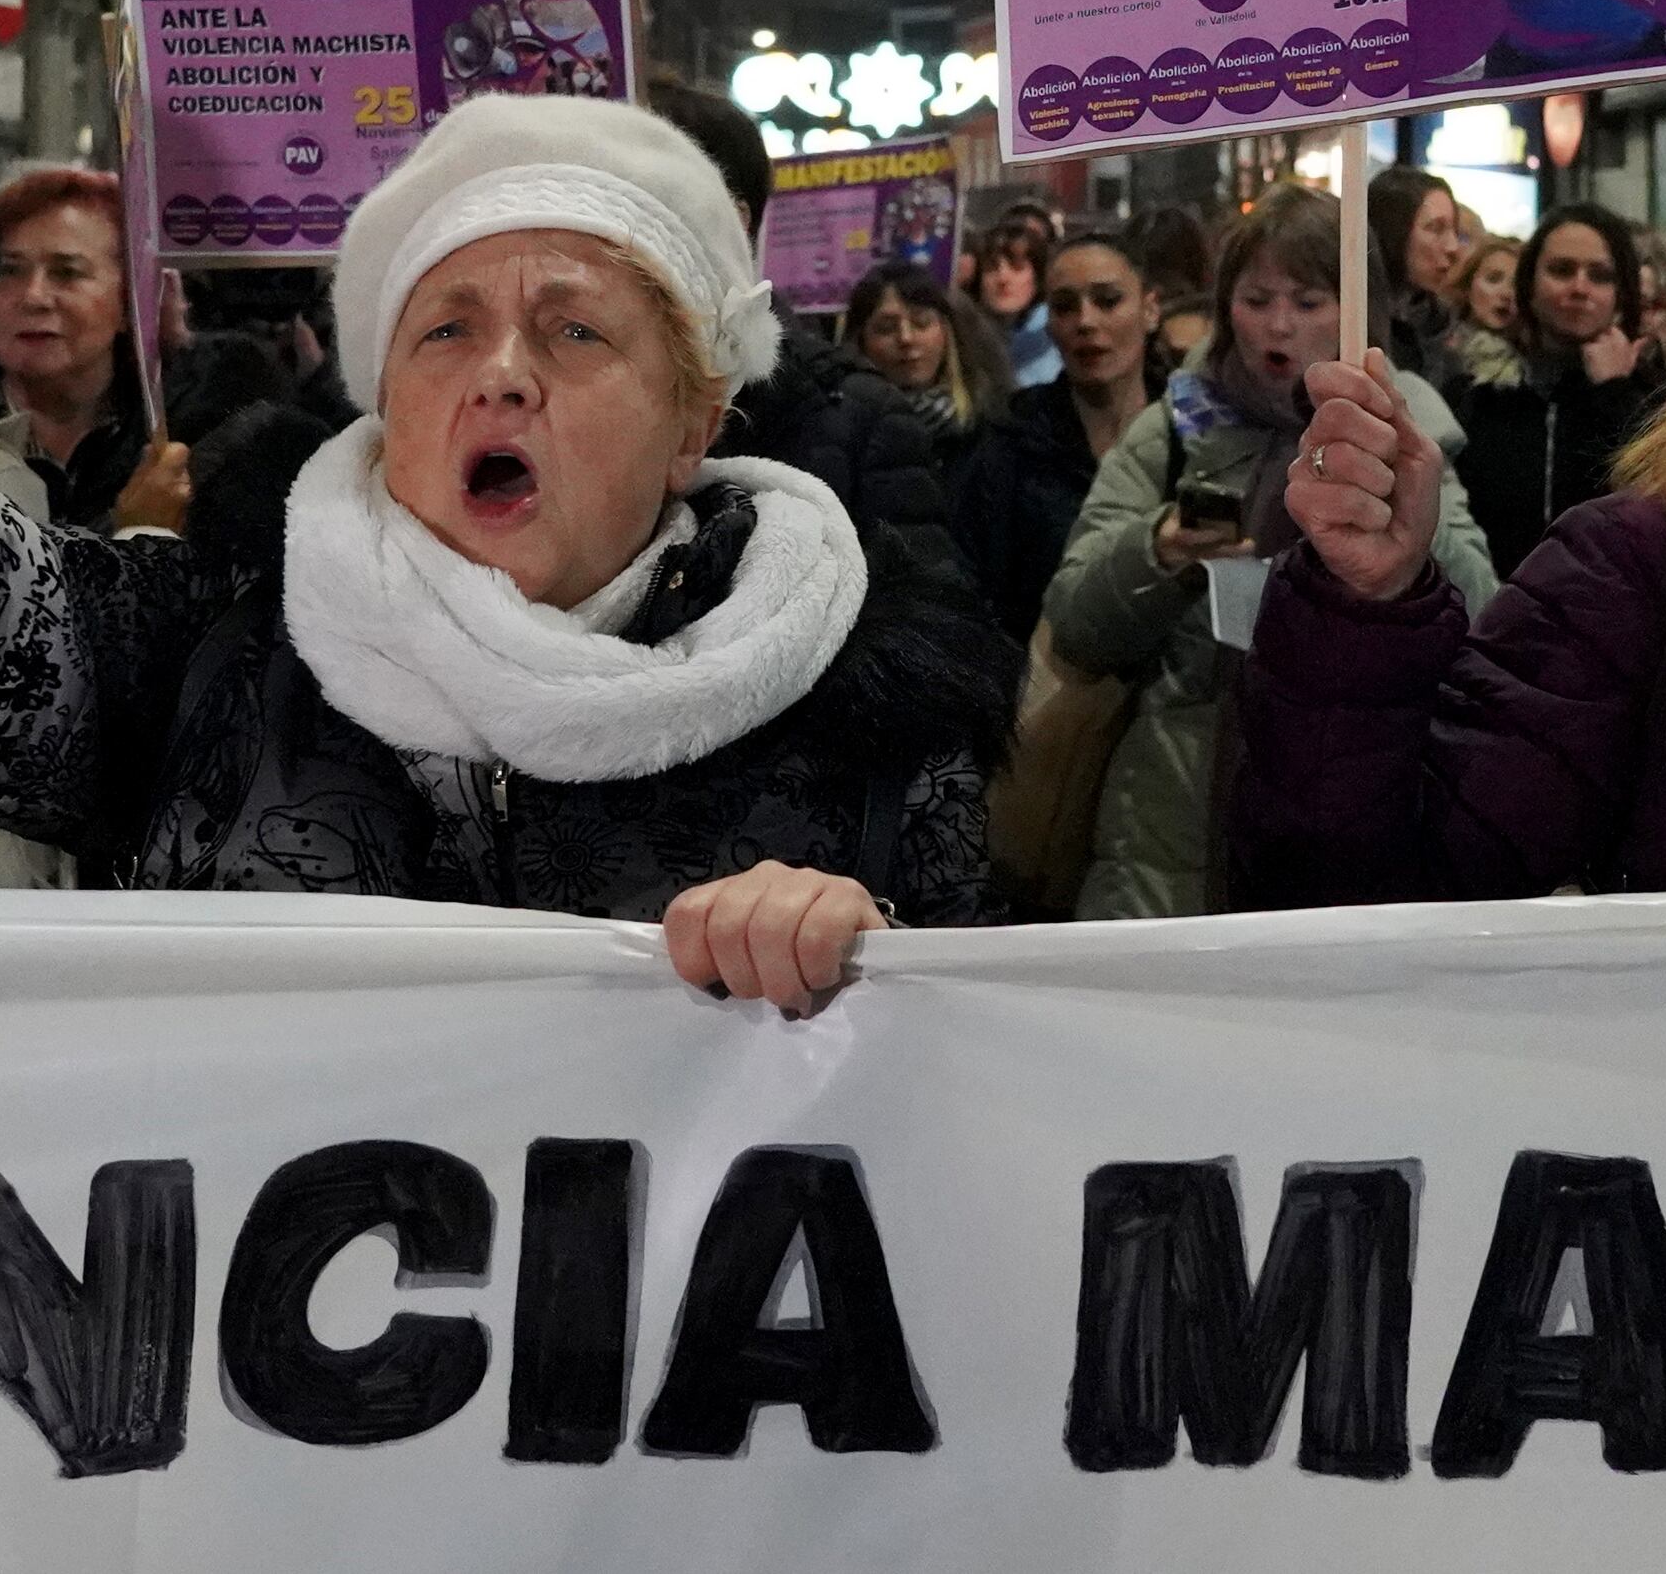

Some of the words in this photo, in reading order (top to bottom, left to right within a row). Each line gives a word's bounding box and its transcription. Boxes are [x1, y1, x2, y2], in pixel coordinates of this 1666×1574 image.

[161, 7, 228, 30] ANTE
[235, 7, 268, 29] LA
[1067, 11, 1074, 20] a
[1076, 5, 1120, 19] nuestro
[1123, 0, 1162, 13] cortejo
[1209, 10, 1257, 26] Valladolid
[162, 36, 286, 57] VIOLENCIA
[292, 34, 413, 56] MACHISTA
[1282, 41, 1342, 58] Abolición
[1350, 31, 1410, 50] Abolición
[1217, 51, 1275, 69] Abolición
[166, 60, 298, 87] ABOLICIÓN
[309, 66, 325, 84] Y
[1082, 70, 1141, 88] Abolición
[1148, 62, 1207, 80] Abolición
[1285, 68, 1327, 81] Vientres
[1328, 66, 1342, 76] de
[1022, 79, 1077, 99] Abolición
[1295, 79, 1334, 92] Alquiler
[168, 93, 325, 116] COEDUCACIÓN
[353, 85, 418, 126] 25
[1029, 106, 1070, 120] Violencia
[1087, 97, 1140, 111] Agresiones
[1030, 118, 1070, 132] machista
[1092, 110, 1135, 122] sexuales
[285, 146, 320, 165] PAV
